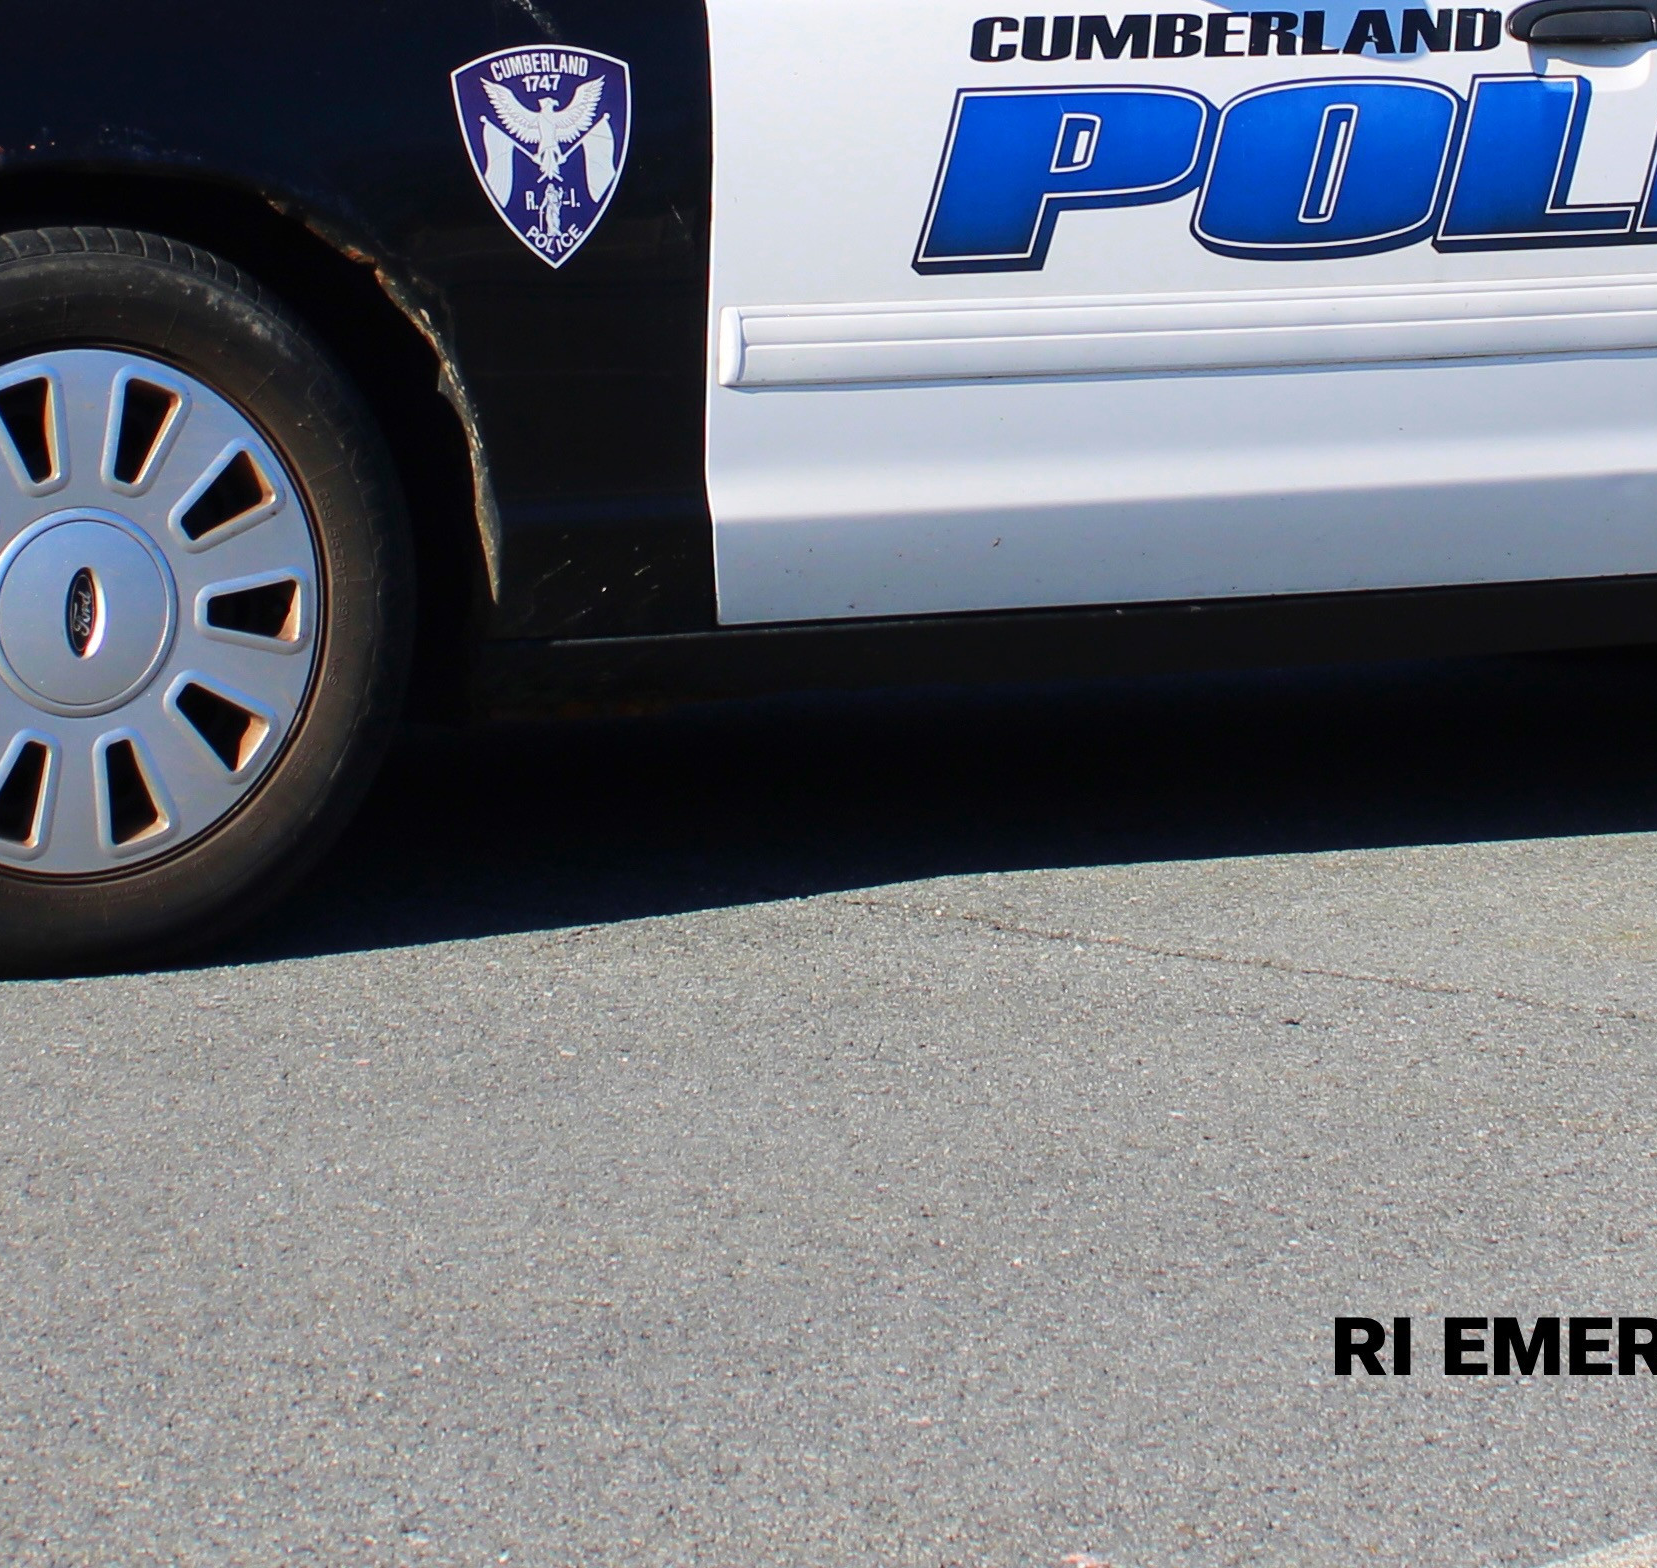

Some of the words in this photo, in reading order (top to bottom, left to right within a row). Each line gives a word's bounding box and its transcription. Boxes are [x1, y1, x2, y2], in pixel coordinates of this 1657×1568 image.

[970, 6, 1504, 63] CUMBERLAND
[490, 52, 589, 82] CUMBERLAND
[522, 74, 561, 93] 1747
[526, 222, 584, 254] POLICE
[72, 590, 93, 637] Ford
